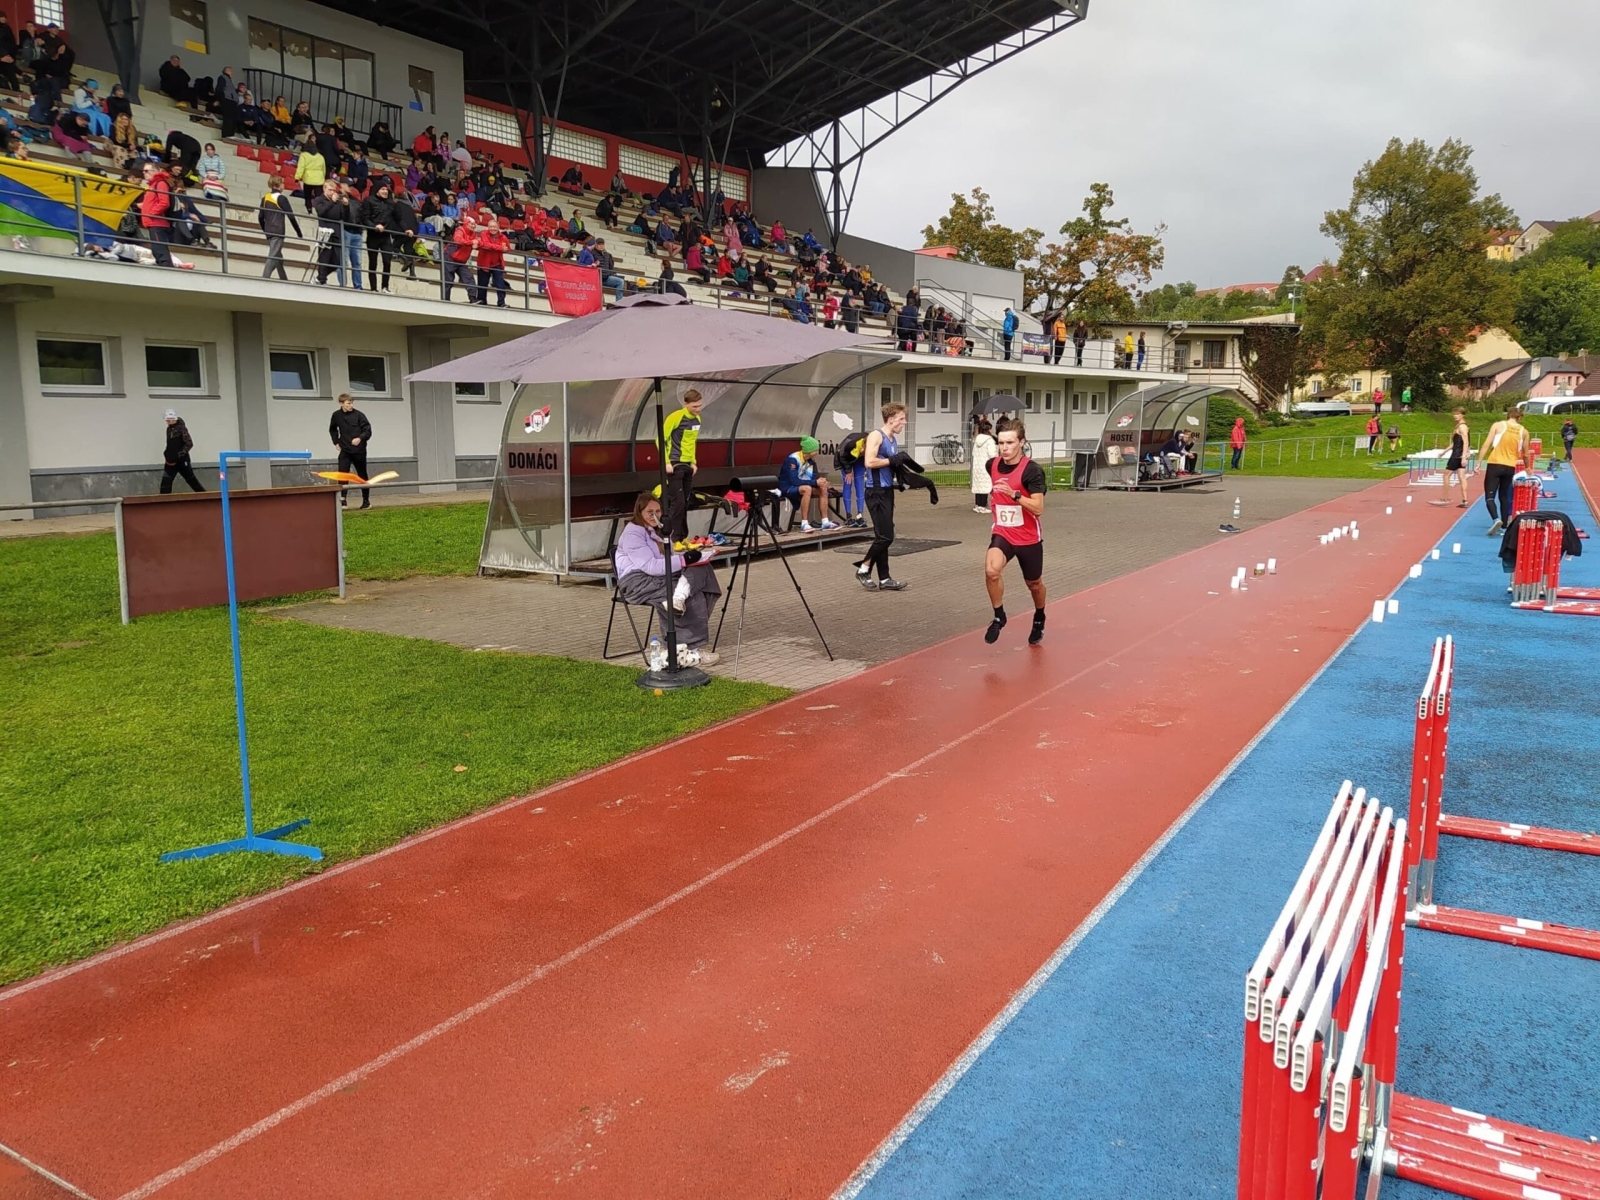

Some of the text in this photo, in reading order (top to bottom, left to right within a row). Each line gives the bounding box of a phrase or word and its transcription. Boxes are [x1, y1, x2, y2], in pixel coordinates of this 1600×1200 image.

[1110, 432, 1134, 442] HOSTÉ
[508, 448, 557, 470] DOMÁCI
[1000, 510, 1016, 523] 67
